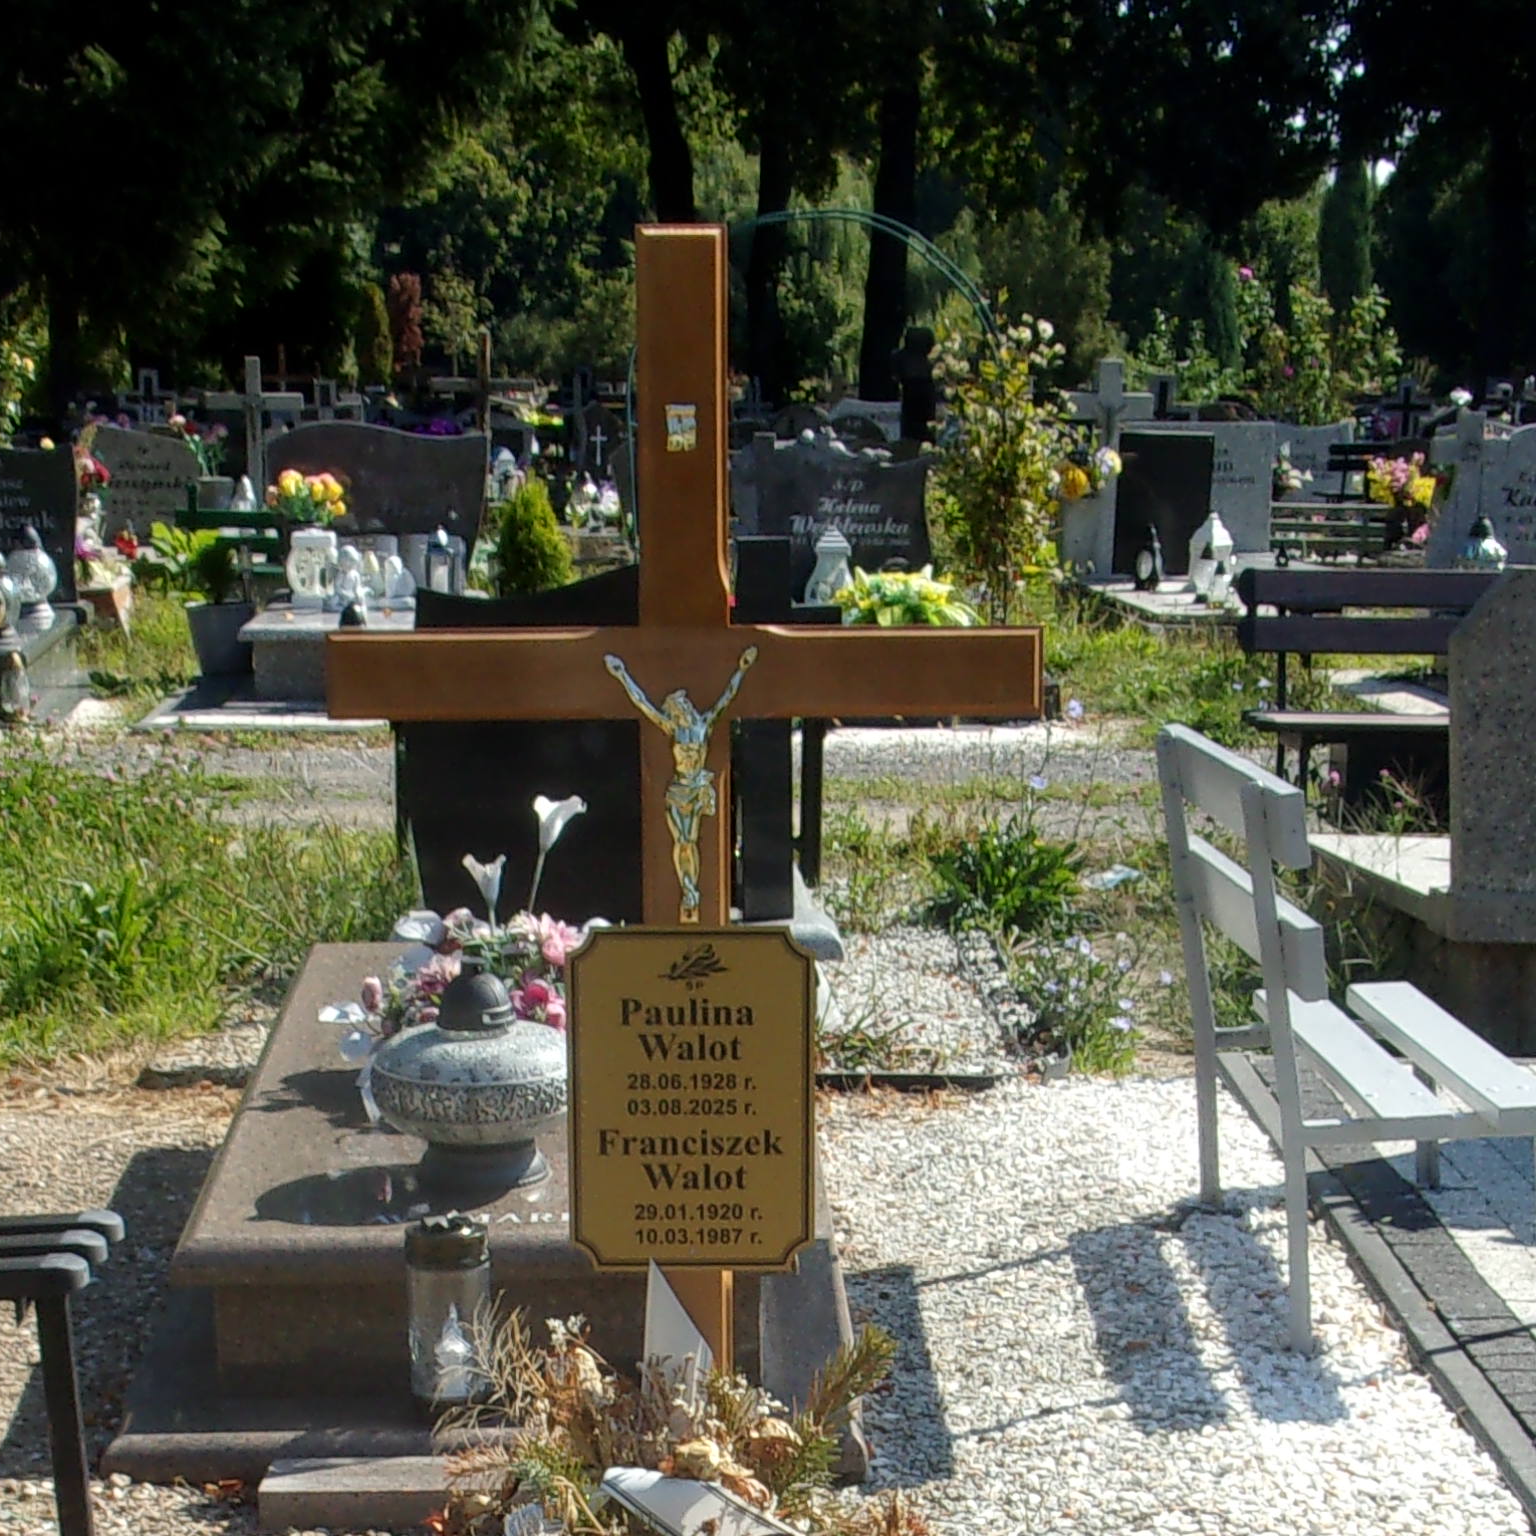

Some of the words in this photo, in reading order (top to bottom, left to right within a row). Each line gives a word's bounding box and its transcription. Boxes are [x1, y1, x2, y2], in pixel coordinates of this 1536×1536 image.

[620, 998, 755, 1028] Paulina
[638, 1034, 743, 1062] Walot
[626, 1073, 737, 1091] 28.06.1928
[744, 1077, 757, 1091] r.
[626, 1099, 738, 1116] 03.08.2025
[744, 1103, 757, 1116] r.
[597, 1129, 784, 1157] Franciszek
[642, 1164, 748, 1192] Walot
[468, 1211, 569, 1225] MARI
[633, 1203, 743, 1221] 29.01.1920
[750, 1207, 763, 1221] r.
[634, 1228, 742, 1245] 10.03.1987
[750, 1232, 763, 1245] r.
